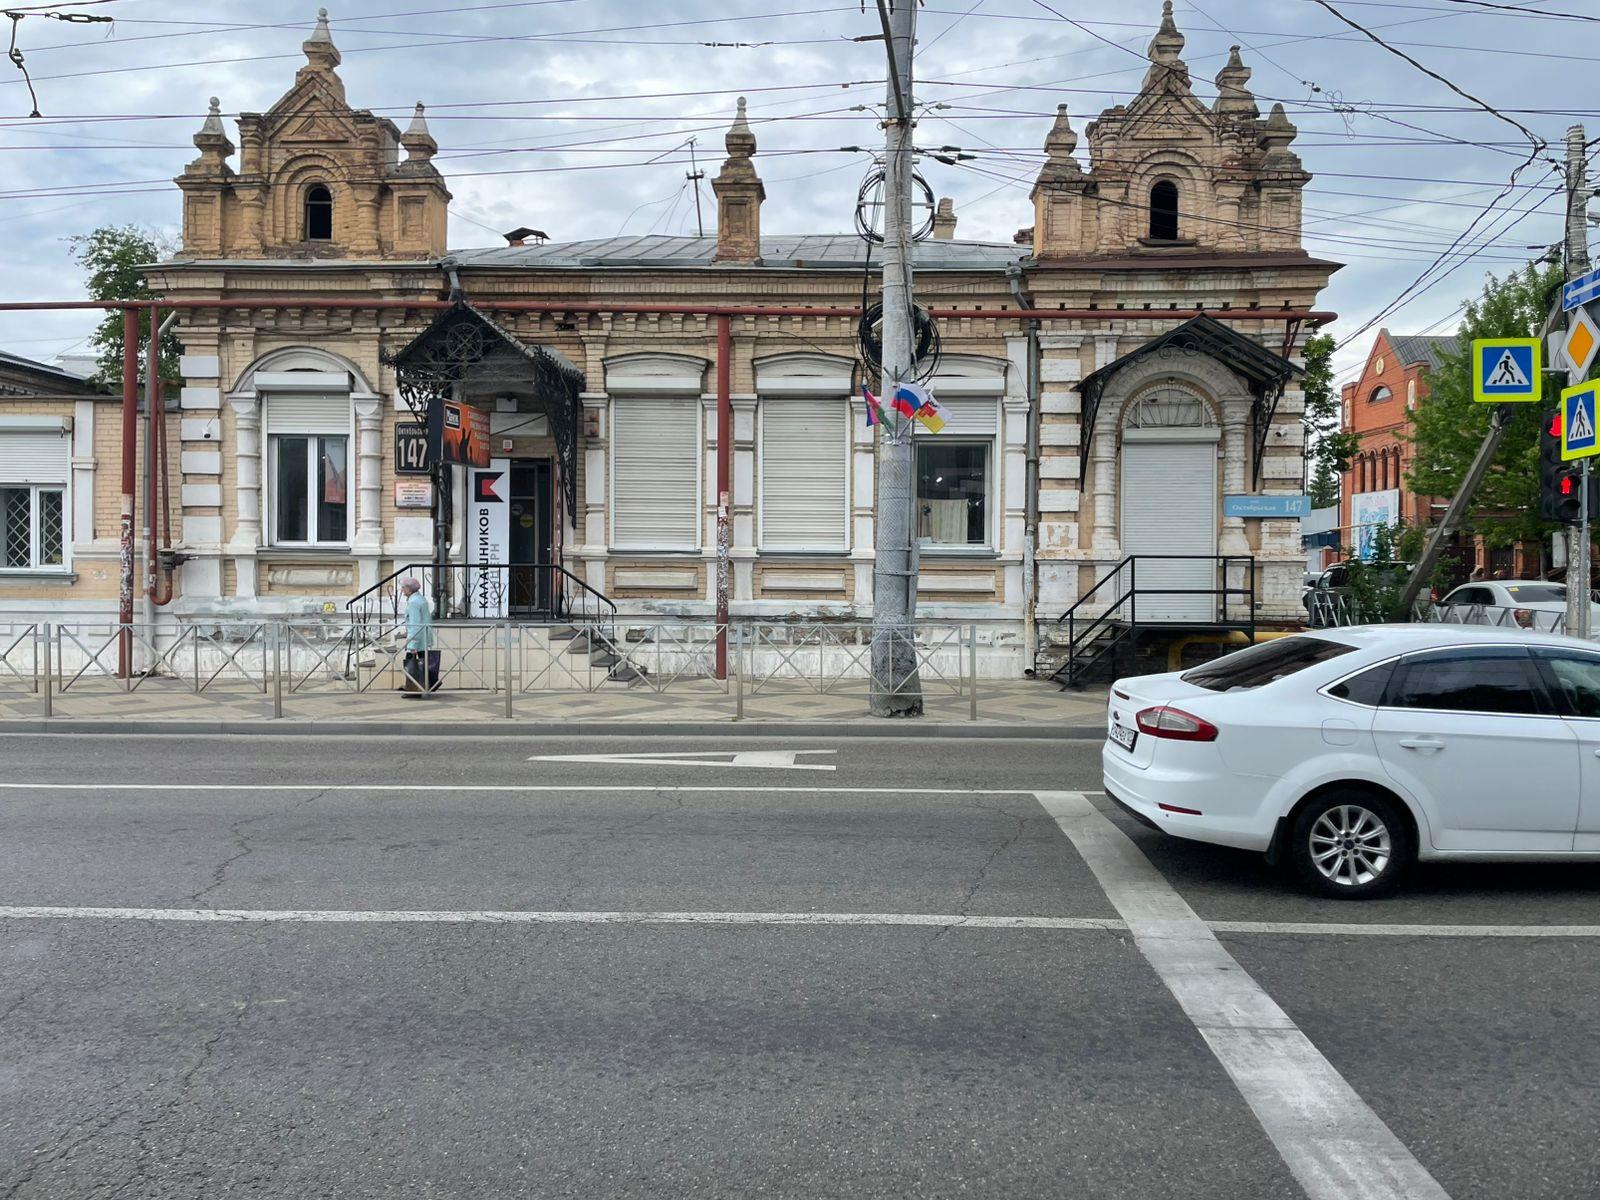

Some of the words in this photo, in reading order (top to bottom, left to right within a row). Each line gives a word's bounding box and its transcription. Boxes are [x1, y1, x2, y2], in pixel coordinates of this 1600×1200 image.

[398, 438, 428, 467] 147
[1285, 500, 1302, 513] 147
[479, 508, 489, 609] КАЛАШНИКОВ
